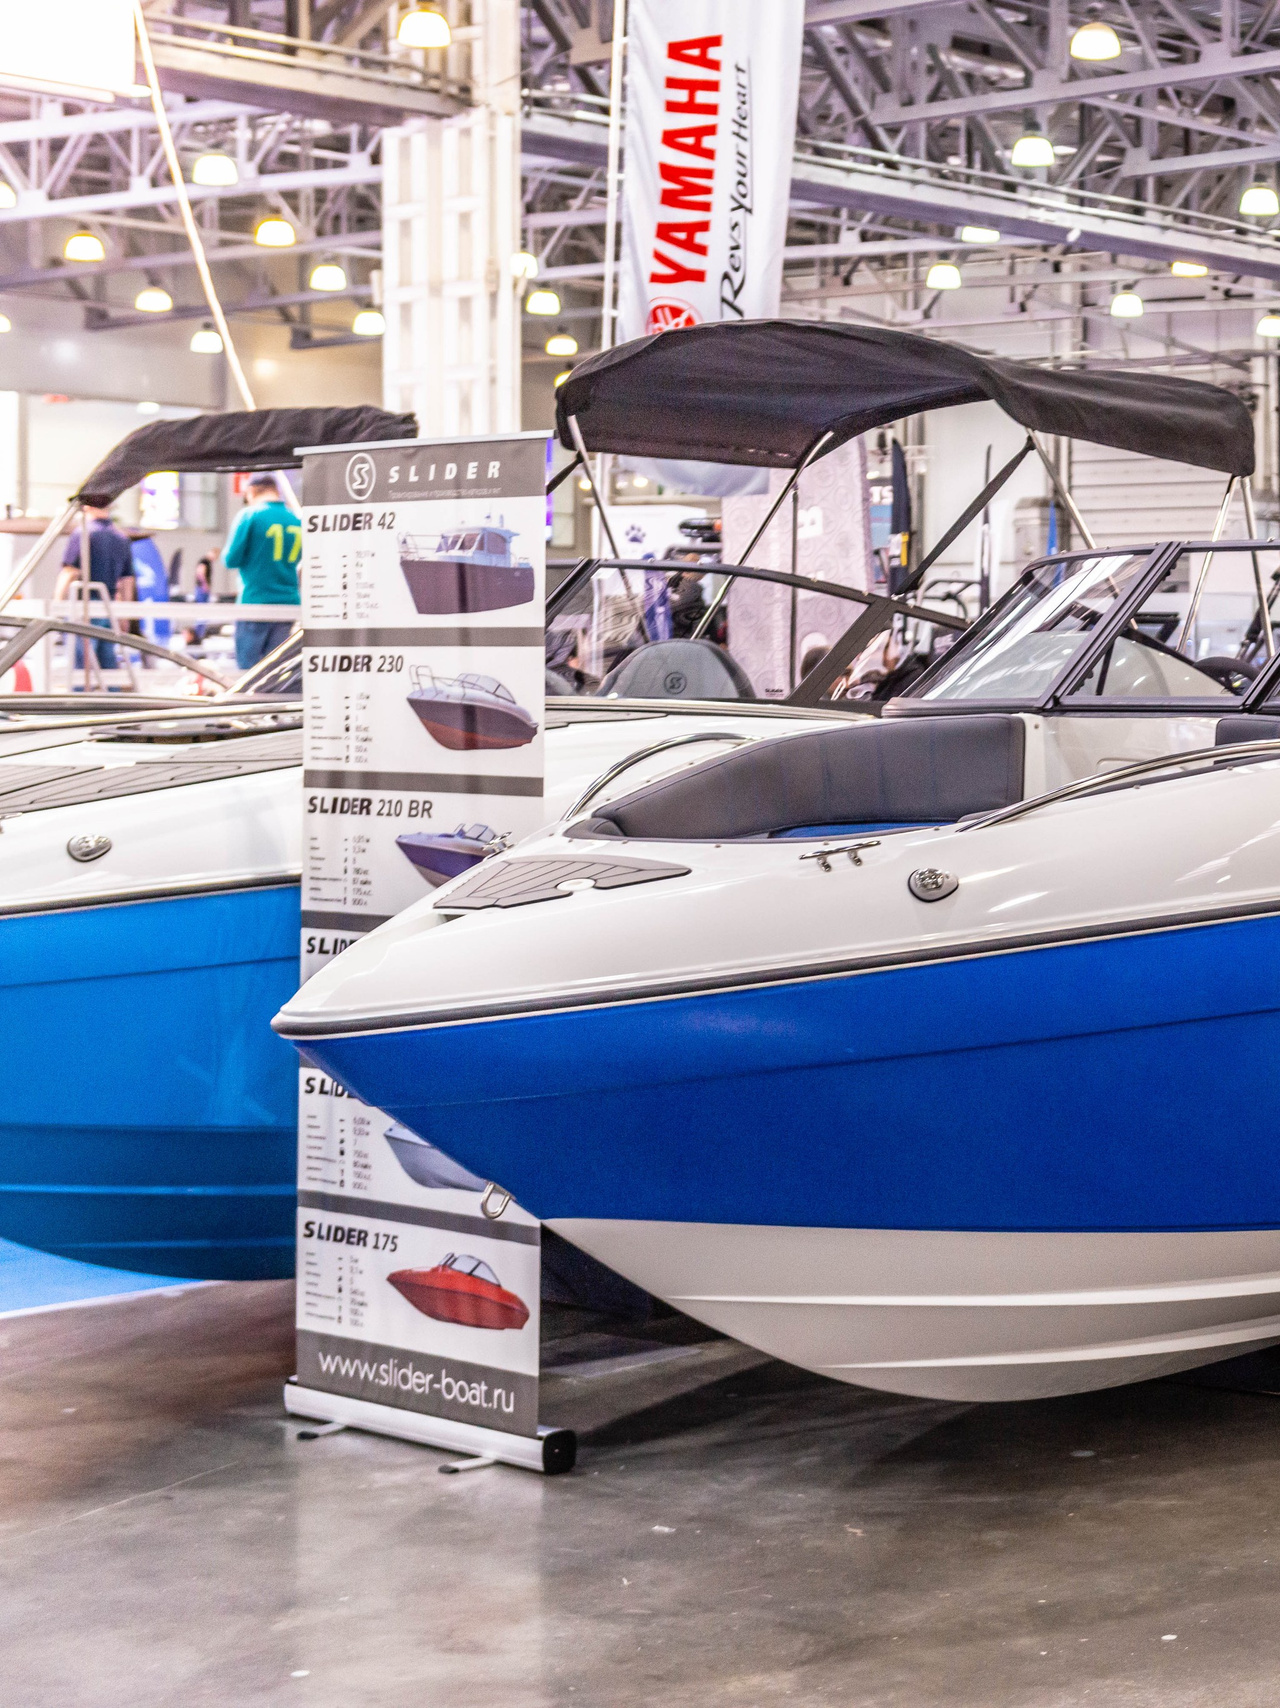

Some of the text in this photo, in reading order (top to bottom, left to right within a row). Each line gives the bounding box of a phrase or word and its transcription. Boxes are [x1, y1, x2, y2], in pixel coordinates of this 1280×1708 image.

[649, 34, 723, 284] YAMAHA
[721, 62, 753, 319] Revs Your Heart
[388, 461, 501, 484] SLIDER
[307, 511, 397, 533] SLIDER 42
[265, 523, 302, 562] 17
[308, 654, 404, 674] SLIDER 230
[307, 795, 433, 819] SLIDER 210 BR
[302, 1220, 399, 1252] SLIDER 175
[318, 1351, 515, 1413] www.slider-boat.ru
